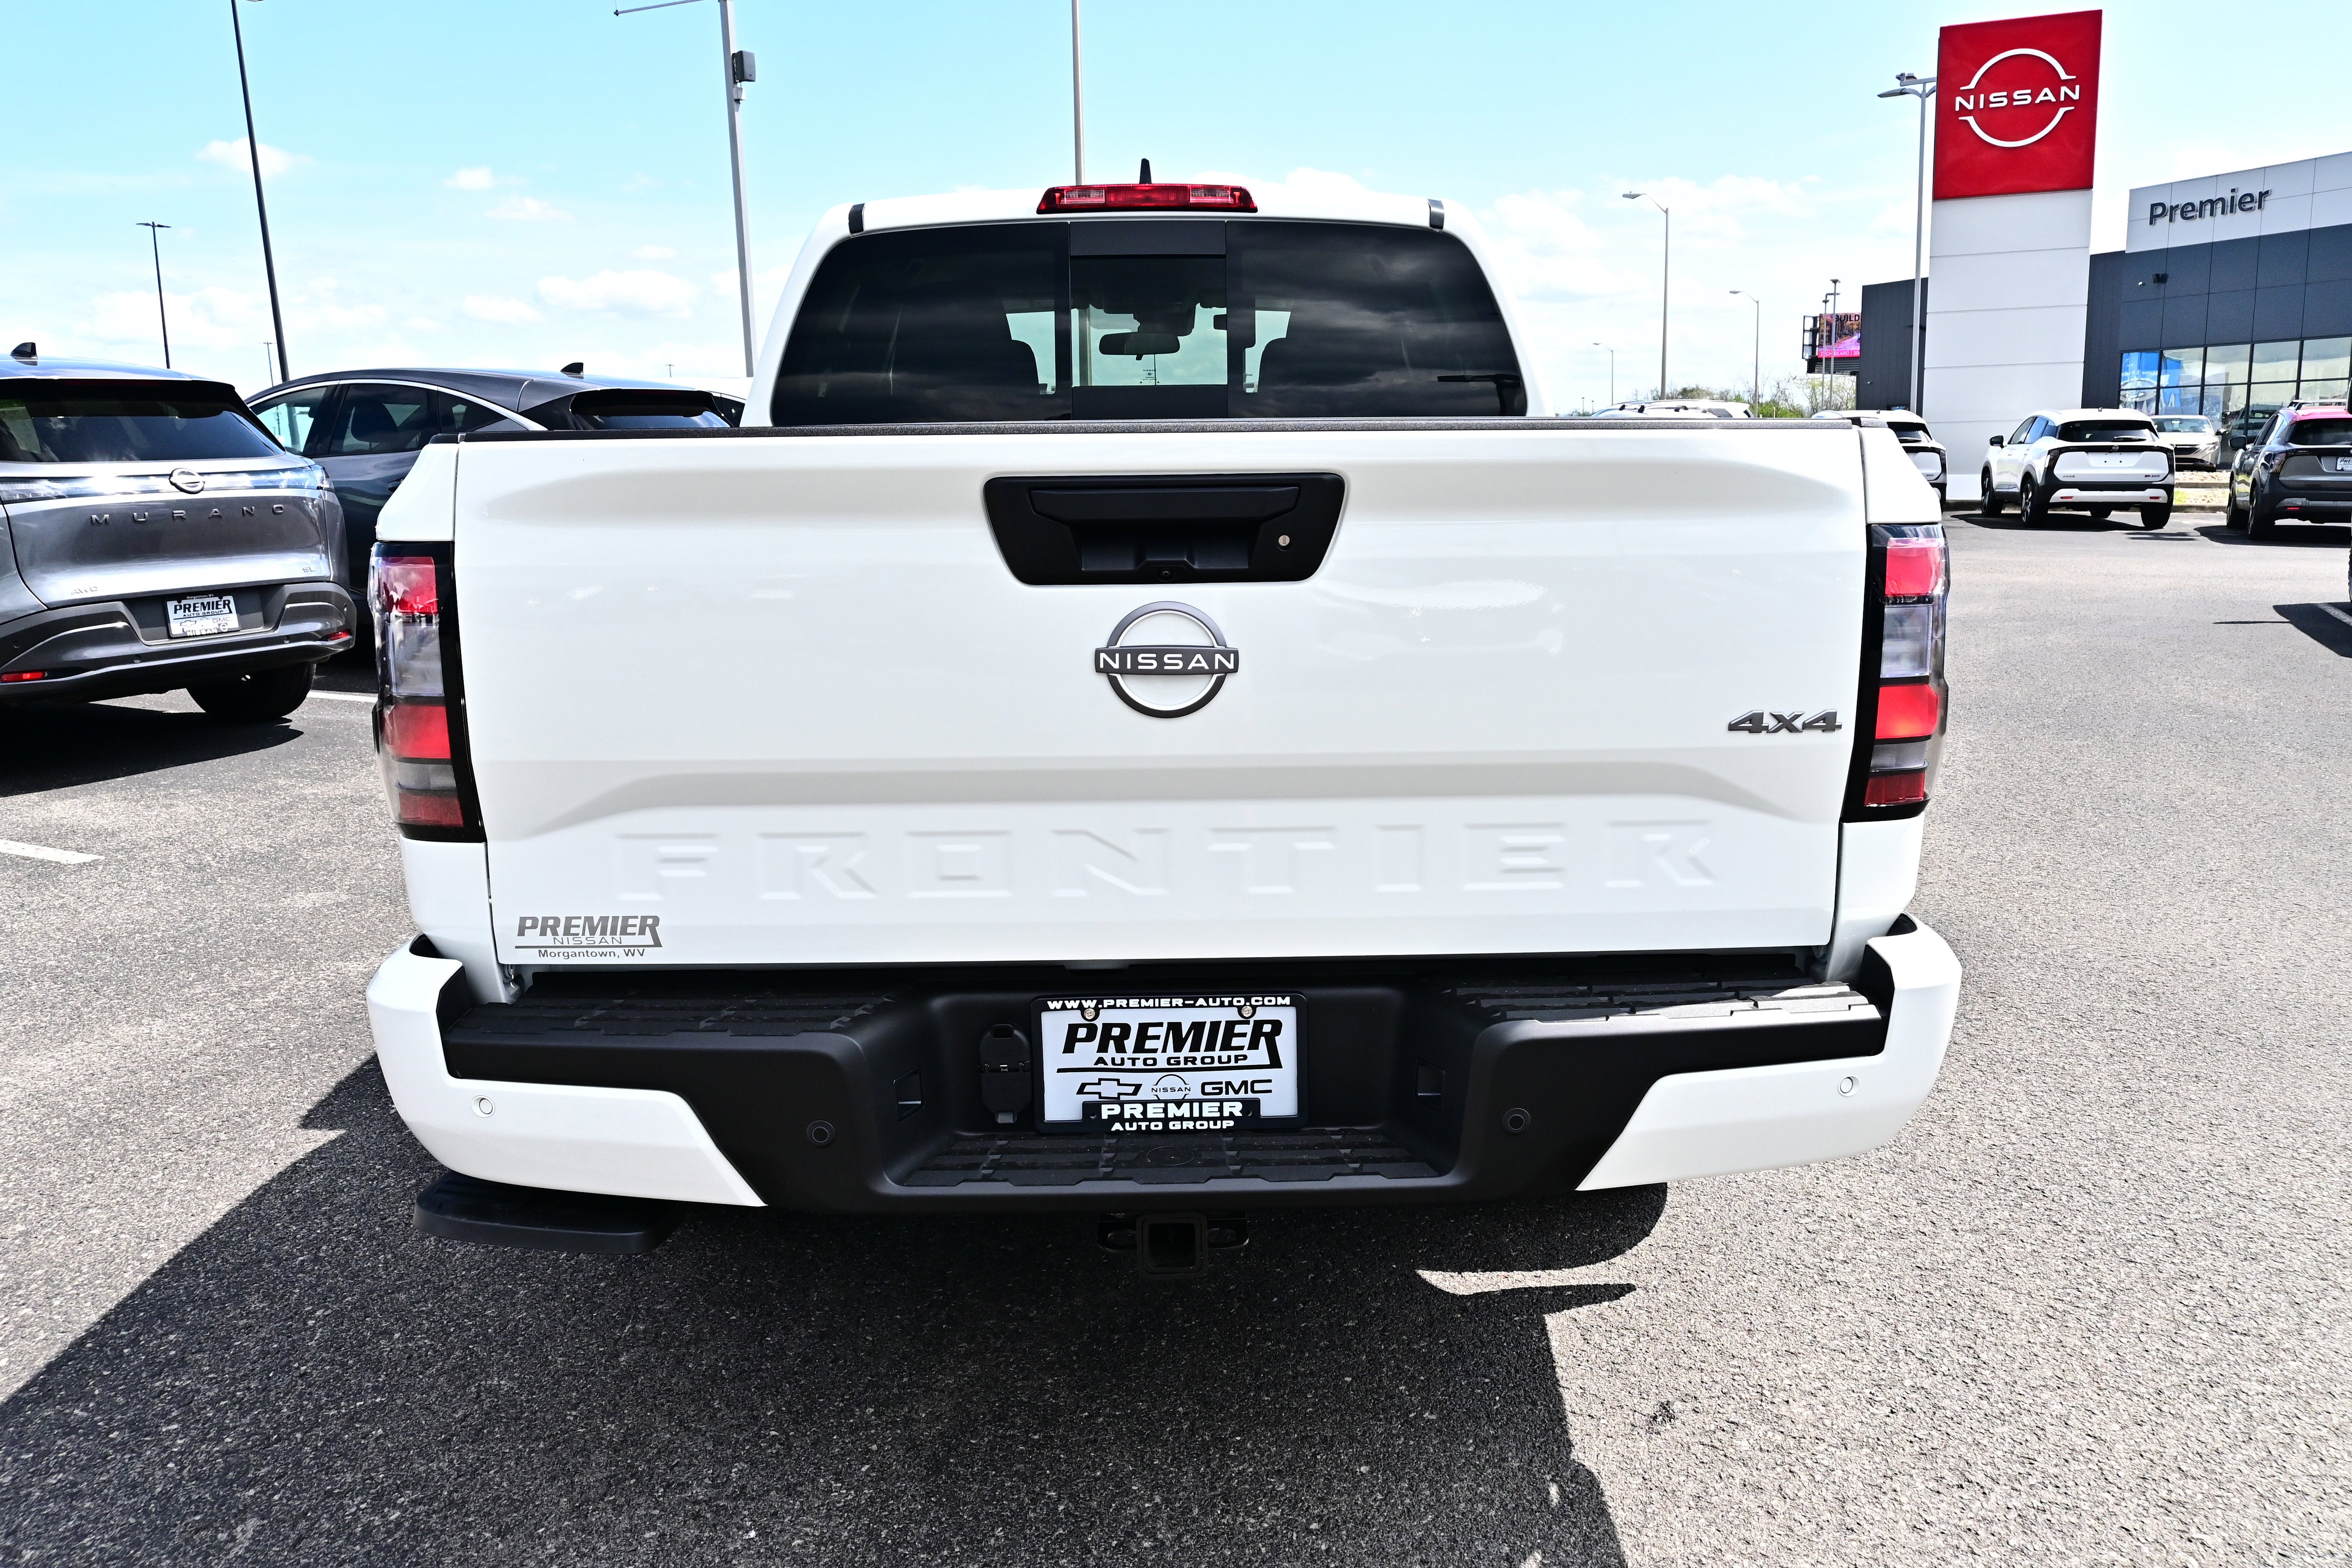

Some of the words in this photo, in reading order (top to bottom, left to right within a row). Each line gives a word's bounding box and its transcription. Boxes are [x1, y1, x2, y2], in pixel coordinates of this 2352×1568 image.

[1955, 84, 2080, 112] NISSAN
[2149, 188, 2270, 225] Premier
[91, 504, 285, 525] MURANO
[174, 600, 232, 614] PREMIER
[1100, 653, 1234, 670] NISSAN
[615, 819, 1718, 901] FRONTIER
[517, 915, 662, 947] PREMIER
[553, 936, 622, 945] NISSAN
[538, 949, 620, 959] Morgantown,
[623, 949, 645, 957] WV
[1047, 996, 1290, 1010] WWW.PREMIER-AUTO.COM
[1062, 1019, 1283, 1068] PREMIER
[1094, 1056, 1157, 1066] AUTO
[1166, 1054, 1248, 1065] GROUP
[1200, 1079, 1272, 1096] GMC
[1101, 1102, 1243, 1119] PREMIER
[1111, 1122, 1163, 1131] AUTO
[1169, 1120, 1235, 1130] GROUP
